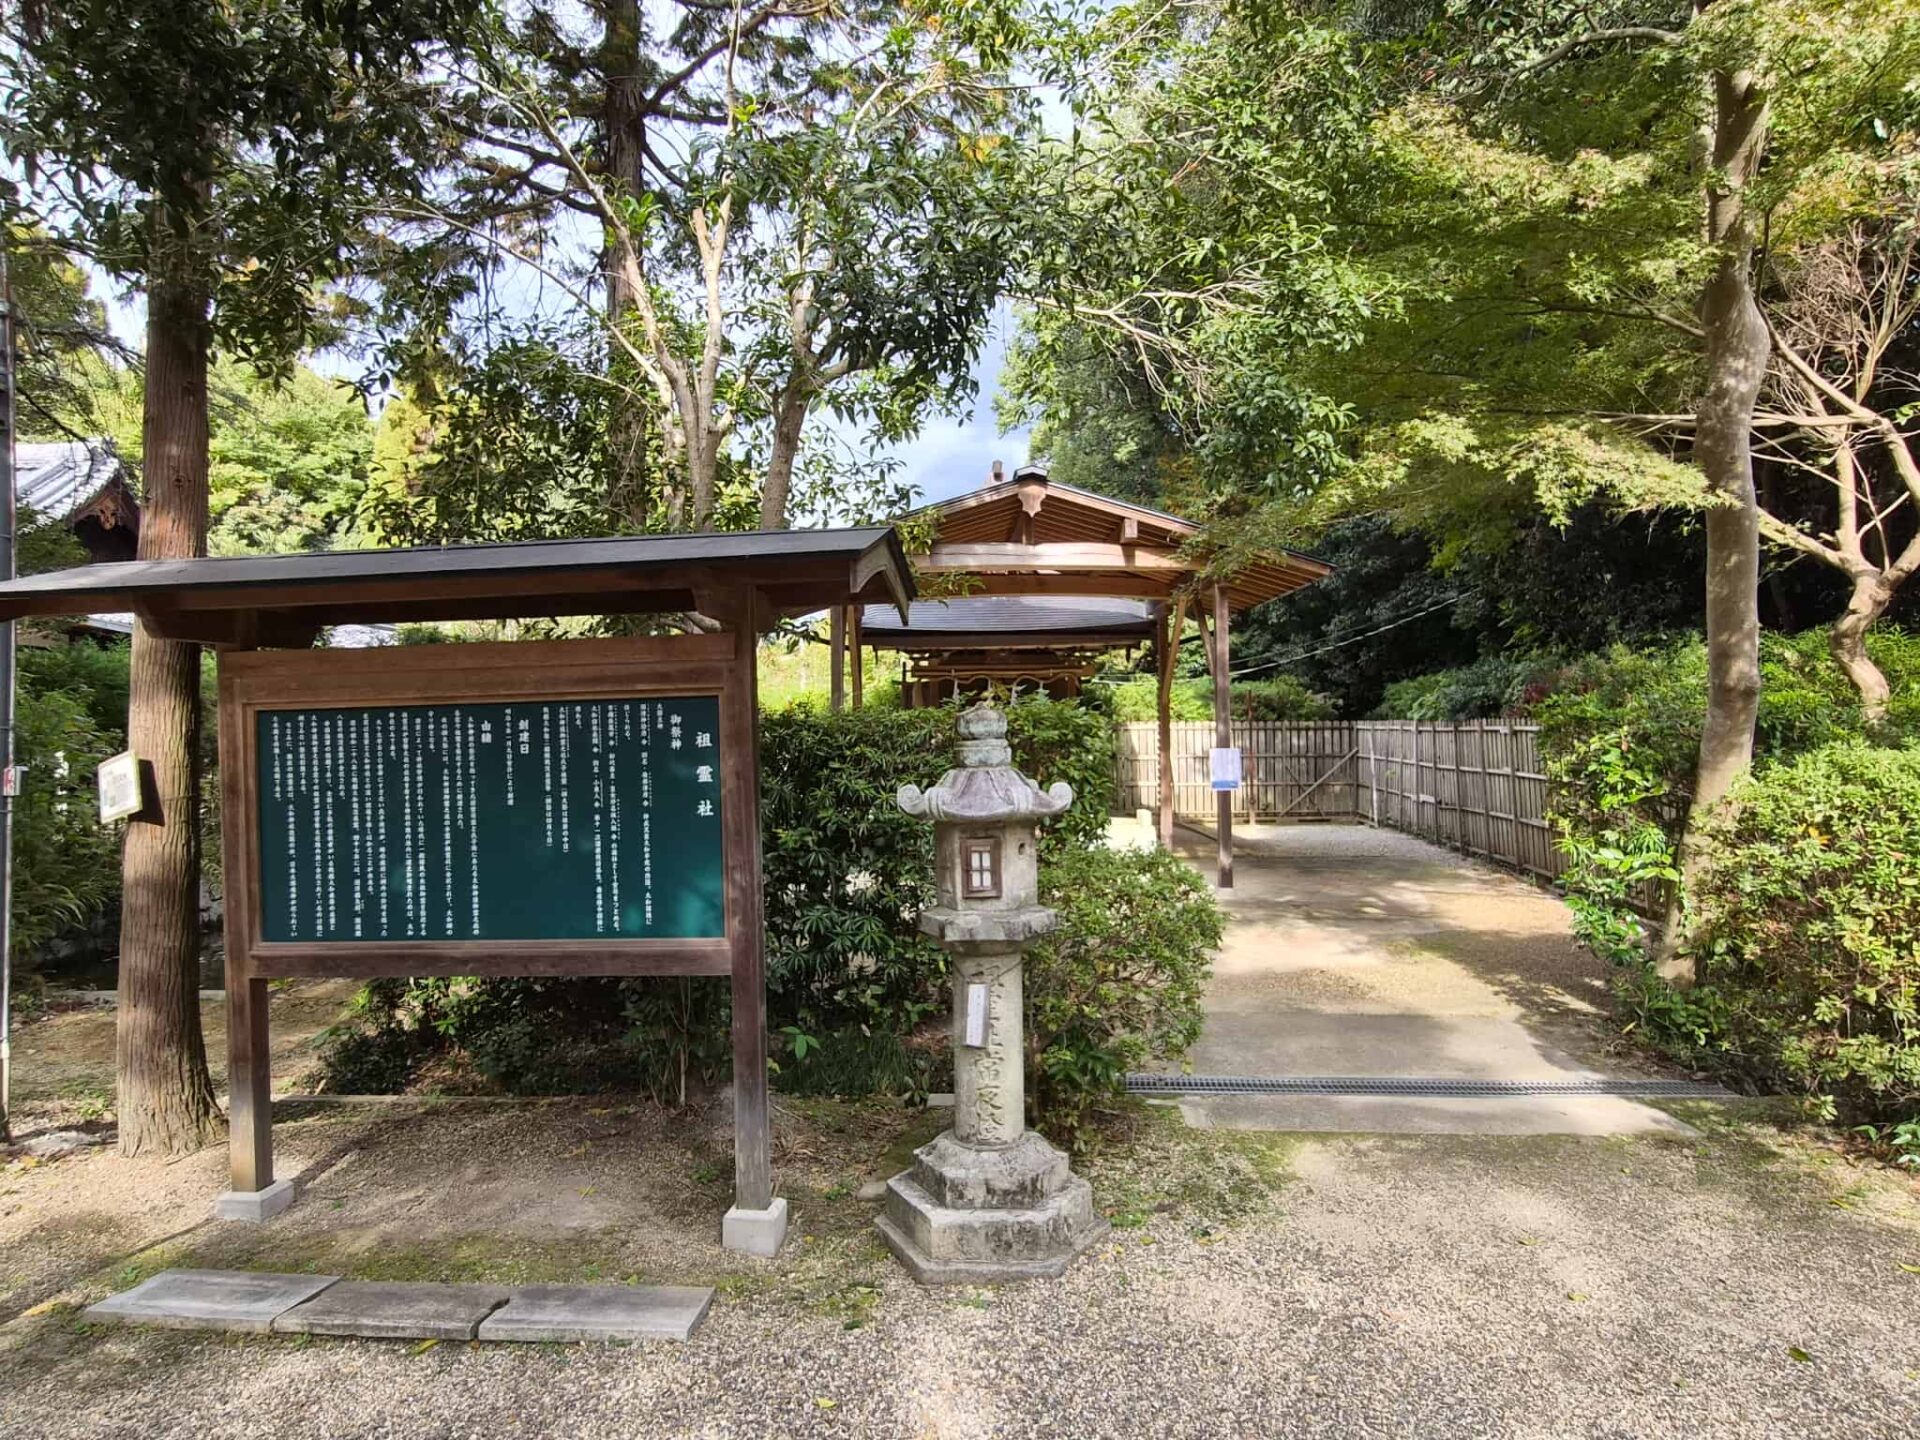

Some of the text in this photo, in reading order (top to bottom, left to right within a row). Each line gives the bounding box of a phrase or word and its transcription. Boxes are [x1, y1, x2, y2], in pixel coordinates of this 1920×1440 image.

[480, 719, 492, 744] 由緒
[518, 719, 530, 755] 創建日
[669, 713, 683, 751] 御祭神
[694, 731, 715, 817] 祖霊社
